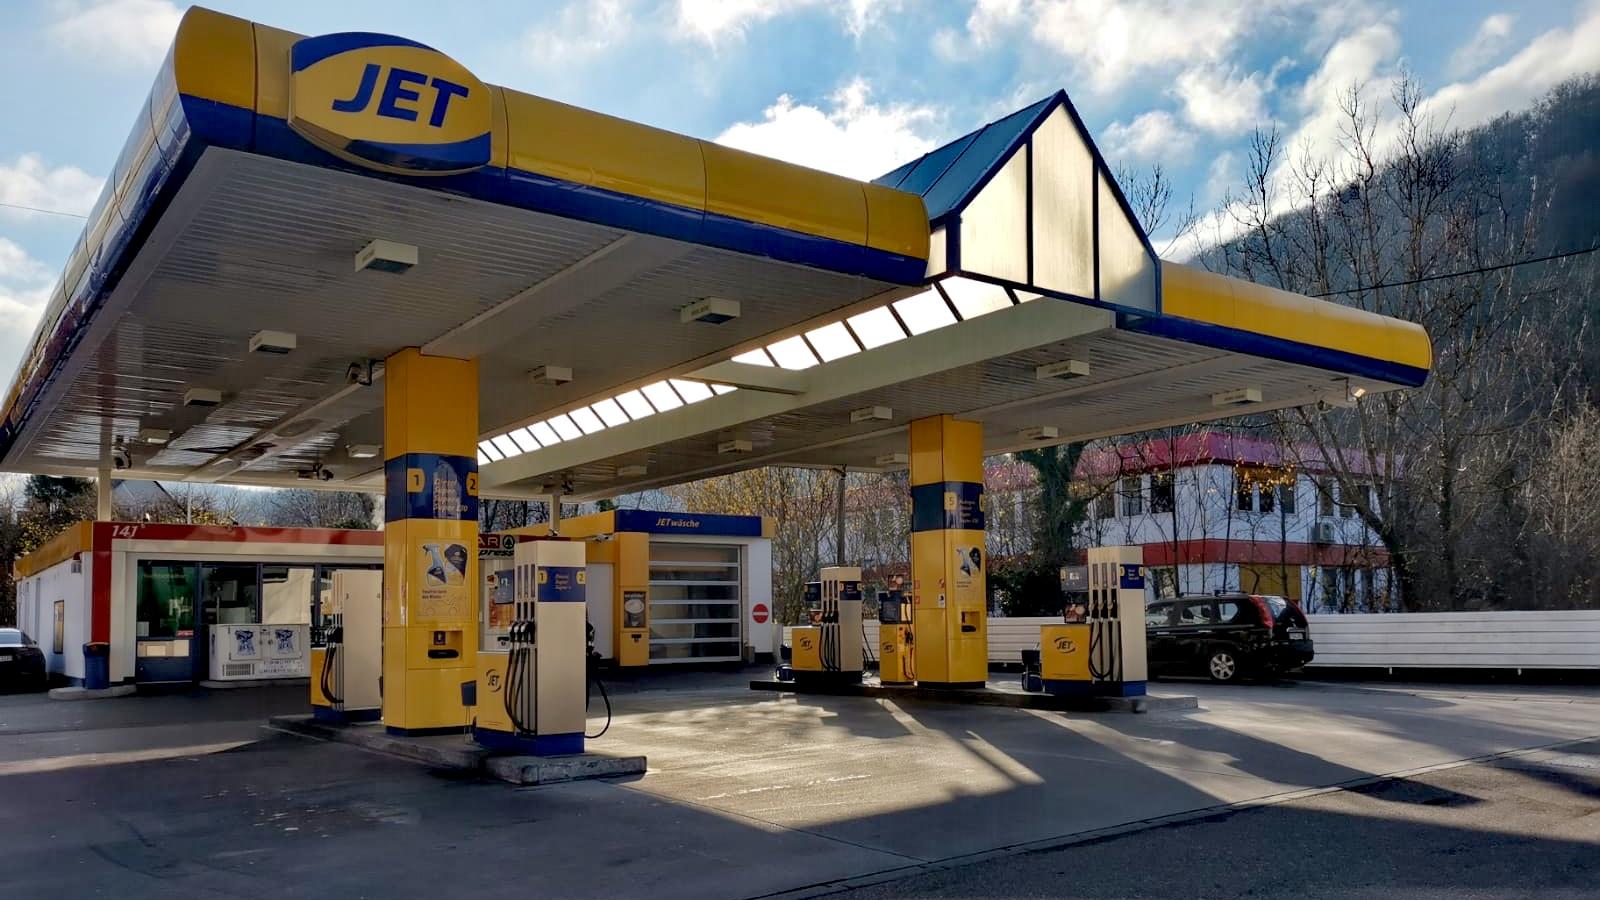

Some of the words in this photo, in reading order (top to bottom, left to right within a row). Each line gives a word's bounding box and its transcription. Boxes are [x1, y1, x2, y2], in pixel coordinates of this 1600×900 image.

[332, 63, 469, 128] JET
[413, 474, 420, 486] 1
[470, 479, 476, 490] 2
[1056, 641, 1074, 650] JET
[487, 675, 500, 686] JET
